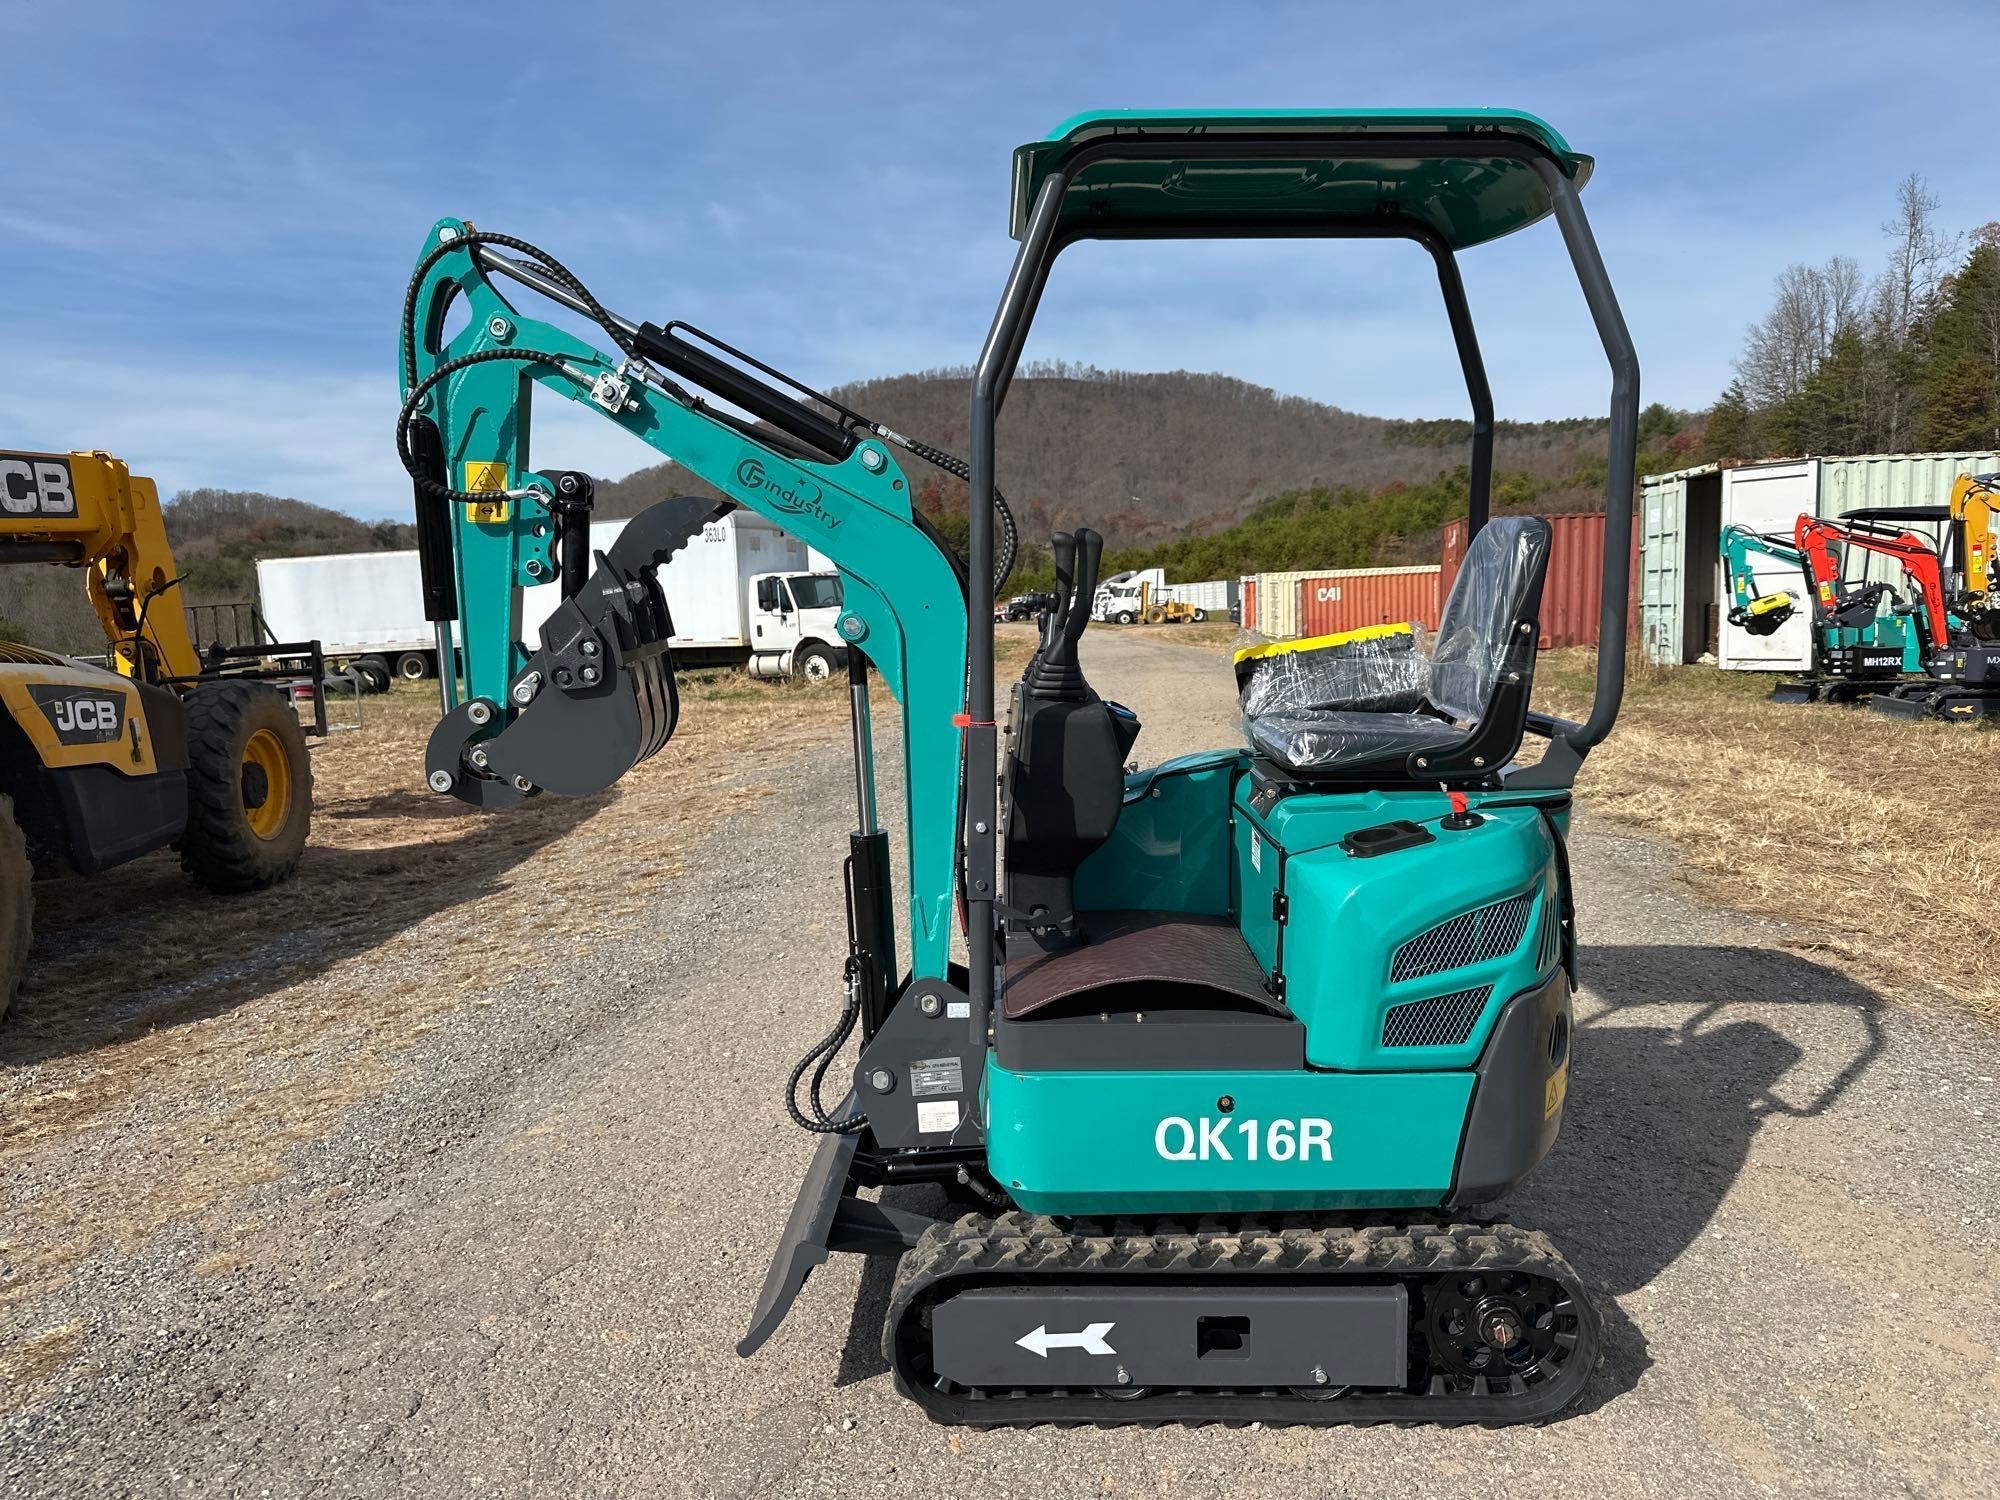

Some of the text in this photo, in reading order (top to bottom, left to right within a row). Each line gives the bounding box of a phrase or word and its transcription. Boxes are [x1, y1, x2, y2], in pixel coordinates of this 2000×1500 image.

[1317, 586, 1341, 602] CAI
[1864, 657, 1902, 667] MH12RX
[56, 700, 118, 731] JCB
[1155, 1116, 1333, 1161] QK16R
